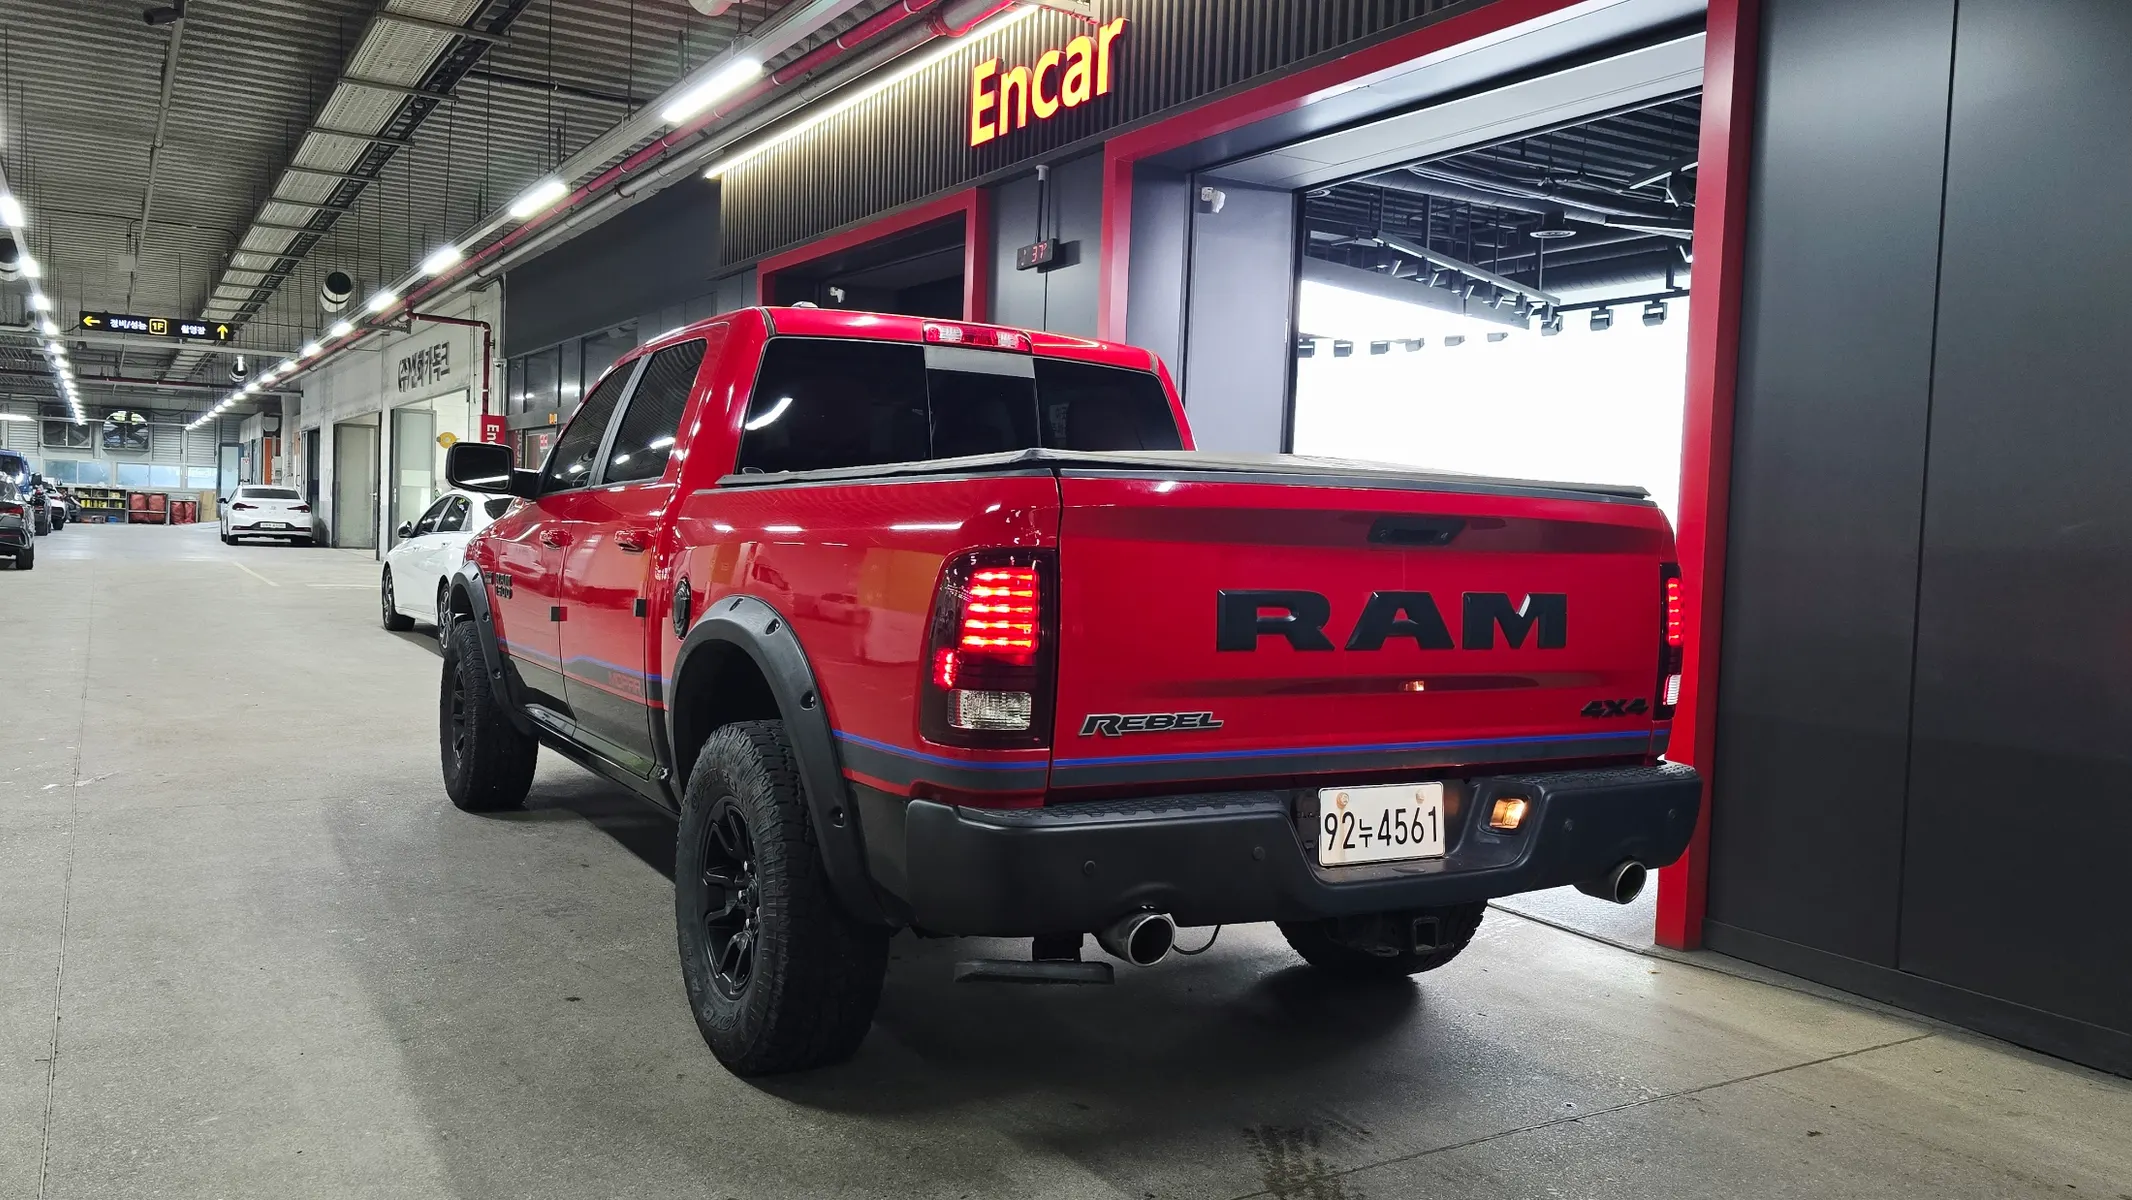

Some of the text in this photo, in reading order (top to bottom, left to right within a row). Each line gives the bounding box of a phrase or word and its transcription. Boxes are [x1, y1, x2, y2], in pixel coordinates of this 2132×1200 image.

[971, 17, 1130, 147] Encar
[152, 322, 164, 332] 1F
[1216, 589, 1568, 652] RAM
[1079, 711, 1224, 737] REBEL
